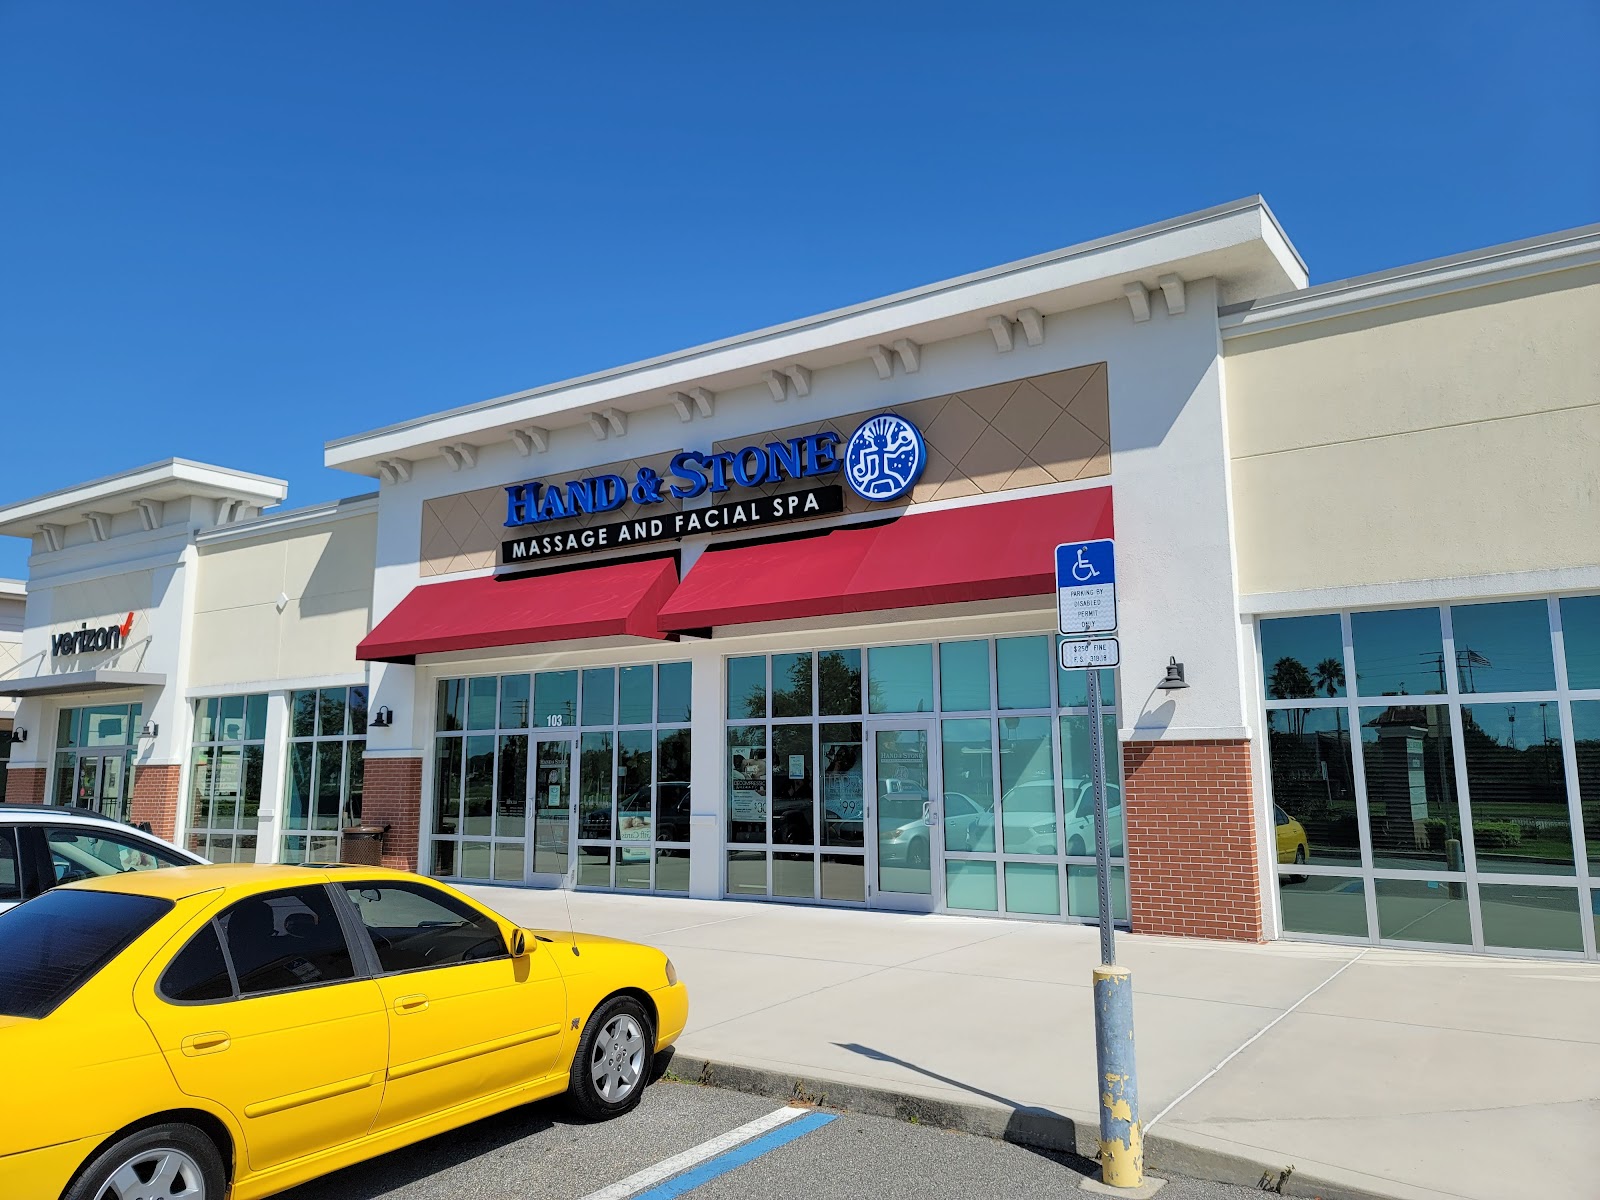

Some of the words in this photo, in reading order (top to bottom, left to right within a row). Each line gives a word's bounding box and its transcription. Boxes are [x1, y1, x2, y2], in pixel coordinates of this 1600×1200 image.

[503, 474, 627, 528] HAND
[631, 466, 665, 505] &
[669, 431, 843, 499] STONE
[512, 532, 608, 558] MASSAGE
[618, 518, 663, 542] AND
[675, 504, 760, 532] FACIAL
[772, 492, 820, 516] SPA
[1070, 589, 1094, 597] PARKING
[1073, 599, 1101, 608] DISABLED
[51, 622, 121, 656] verizon
[546, 714, 563, 727] 103
